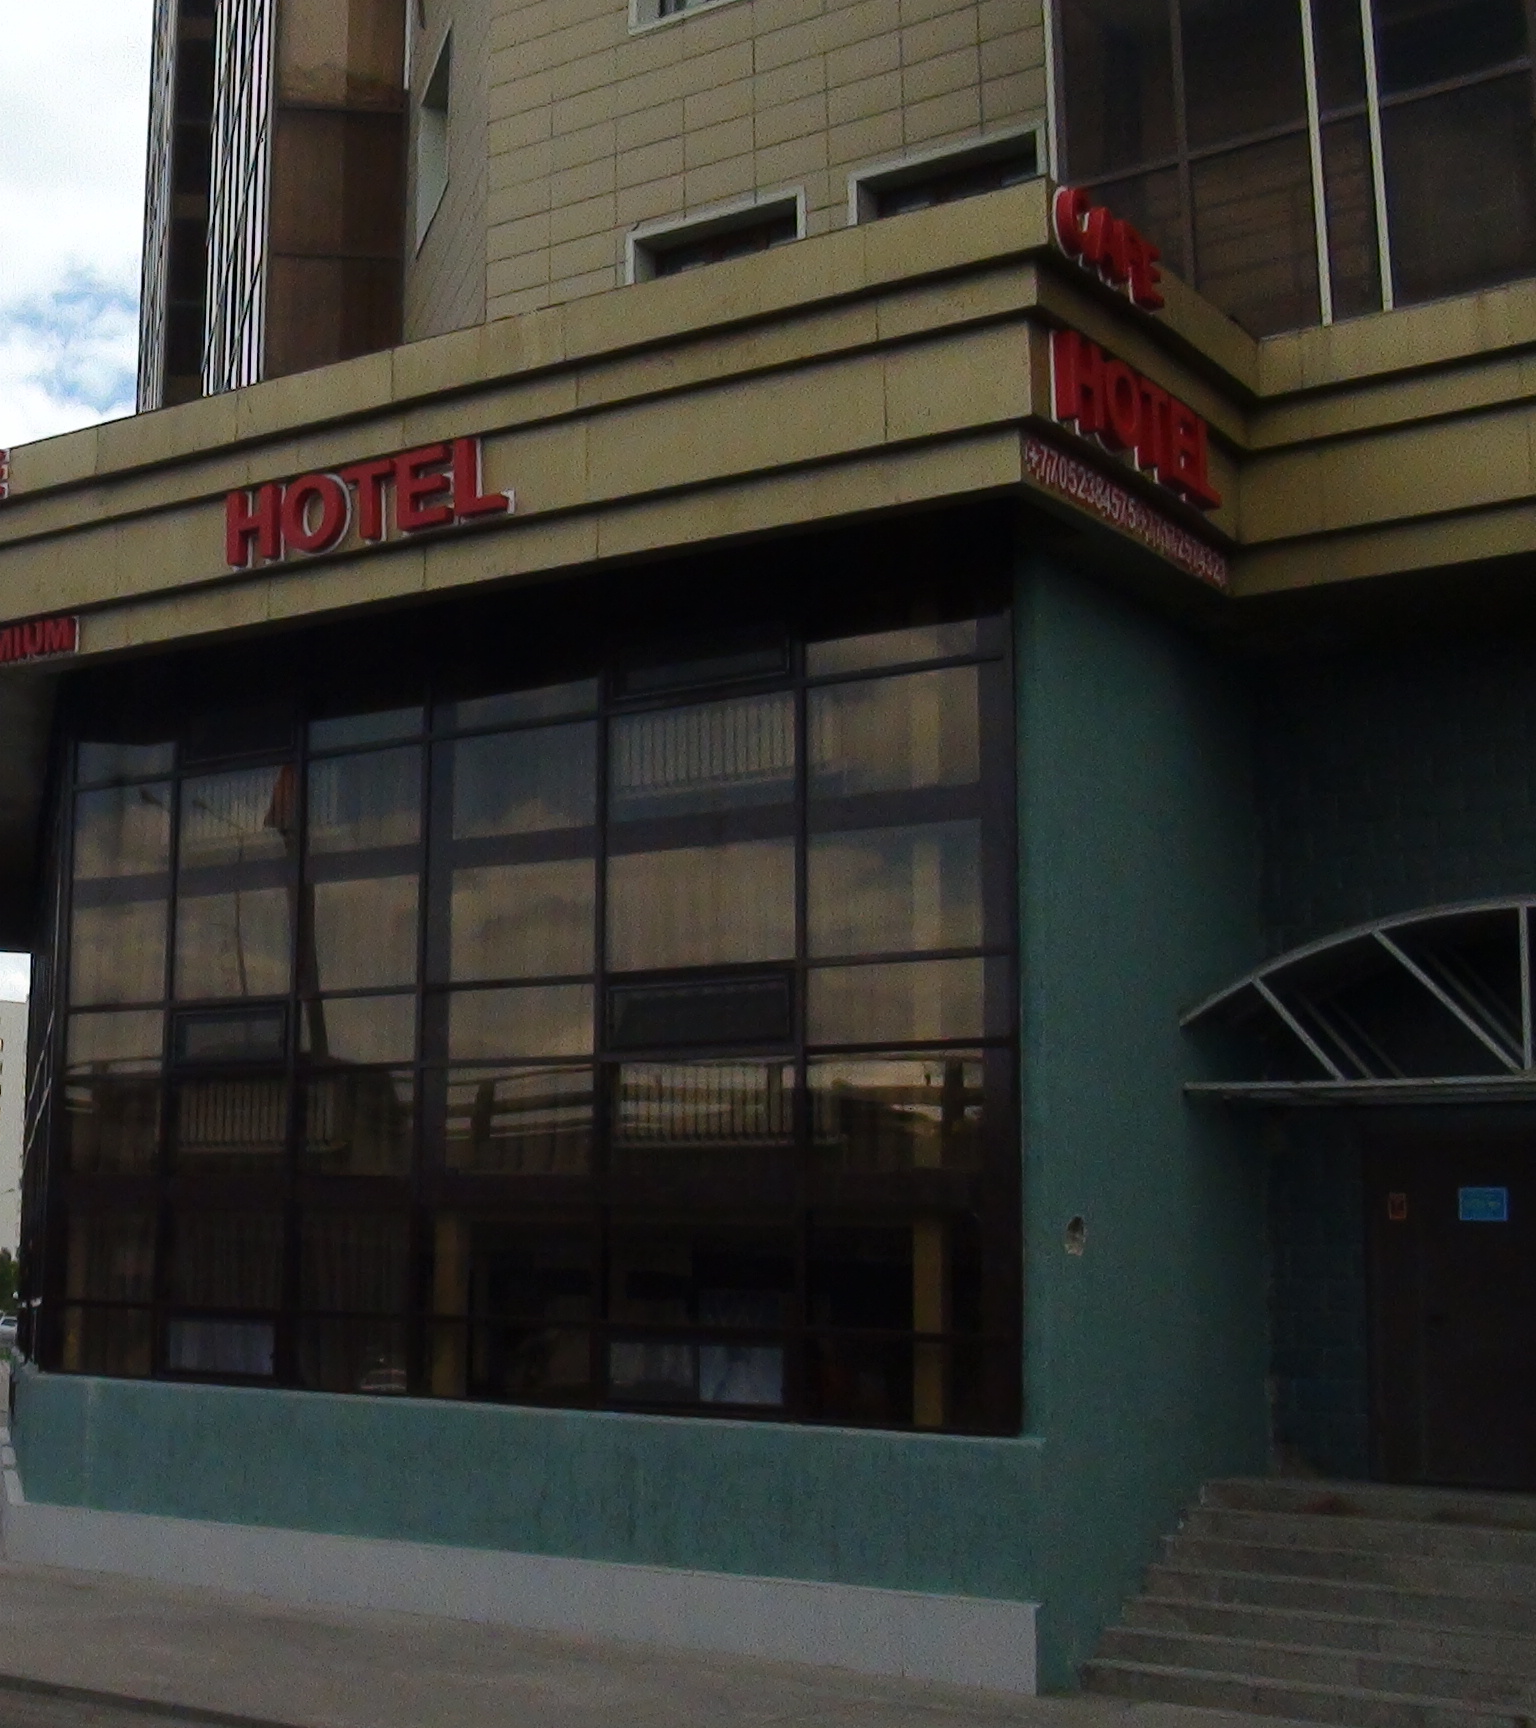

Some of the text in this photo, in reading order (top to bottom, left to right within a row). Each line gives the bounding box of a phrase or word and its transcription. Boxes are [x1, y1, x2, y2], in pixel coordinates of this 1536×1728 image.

[1052, 186, 1165, 312] CAFE
[1050, 330, 1223, 510] HOTEL
[227, 437, 516, 570] HOTEL
